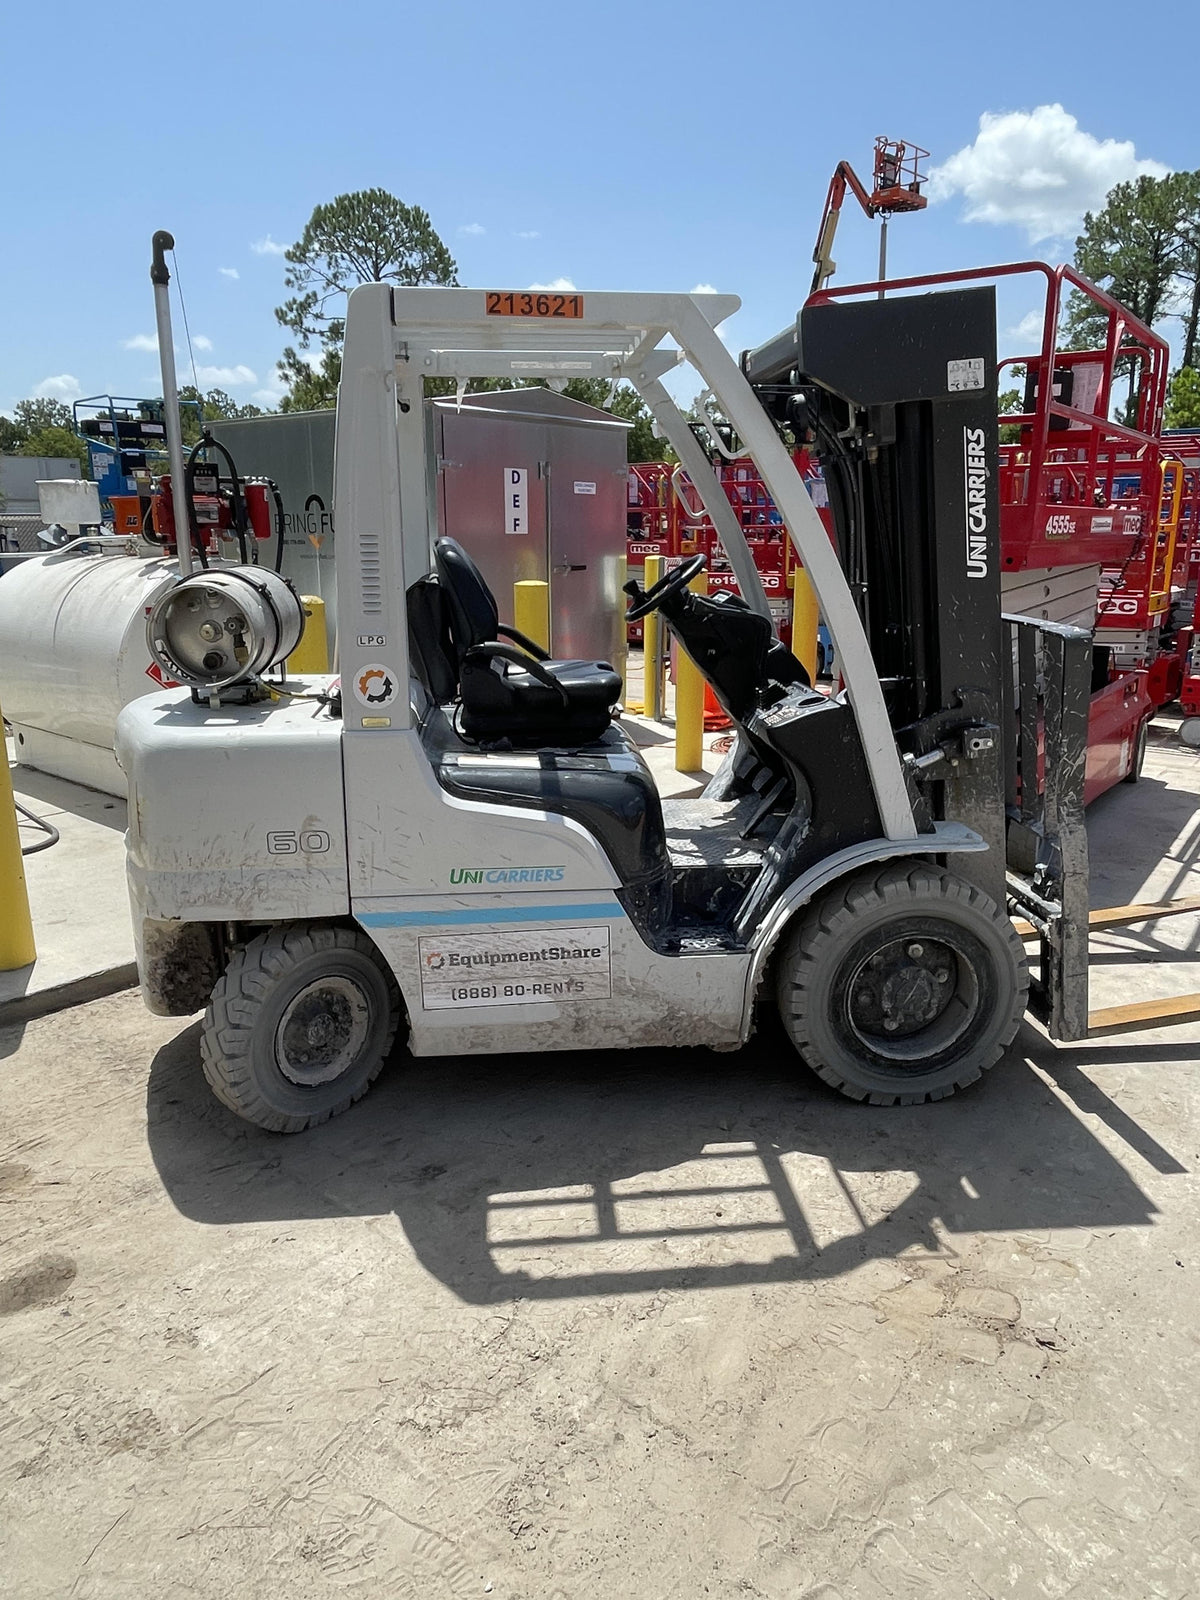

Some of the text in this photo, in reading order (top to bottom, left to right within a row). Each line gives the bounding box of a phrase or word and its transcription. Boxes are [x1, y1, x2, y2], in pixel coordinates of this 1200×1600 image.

[488, 292, 579, 317] 213621
[126, 516, 138, 525] JLG
[274, 513, 317, 534] BRING
[631, 544, 660, 553] mec
[759, 578, 778, 586] ec
[1099, 600, 1136, 613] ec
[359, 636, 385, 645] LPG
[266, 830, 331, 855] 60
[448, 947, 601, 969] EquipmentShare
[451, 981, 585, 1001] (888) 80-RENTS
